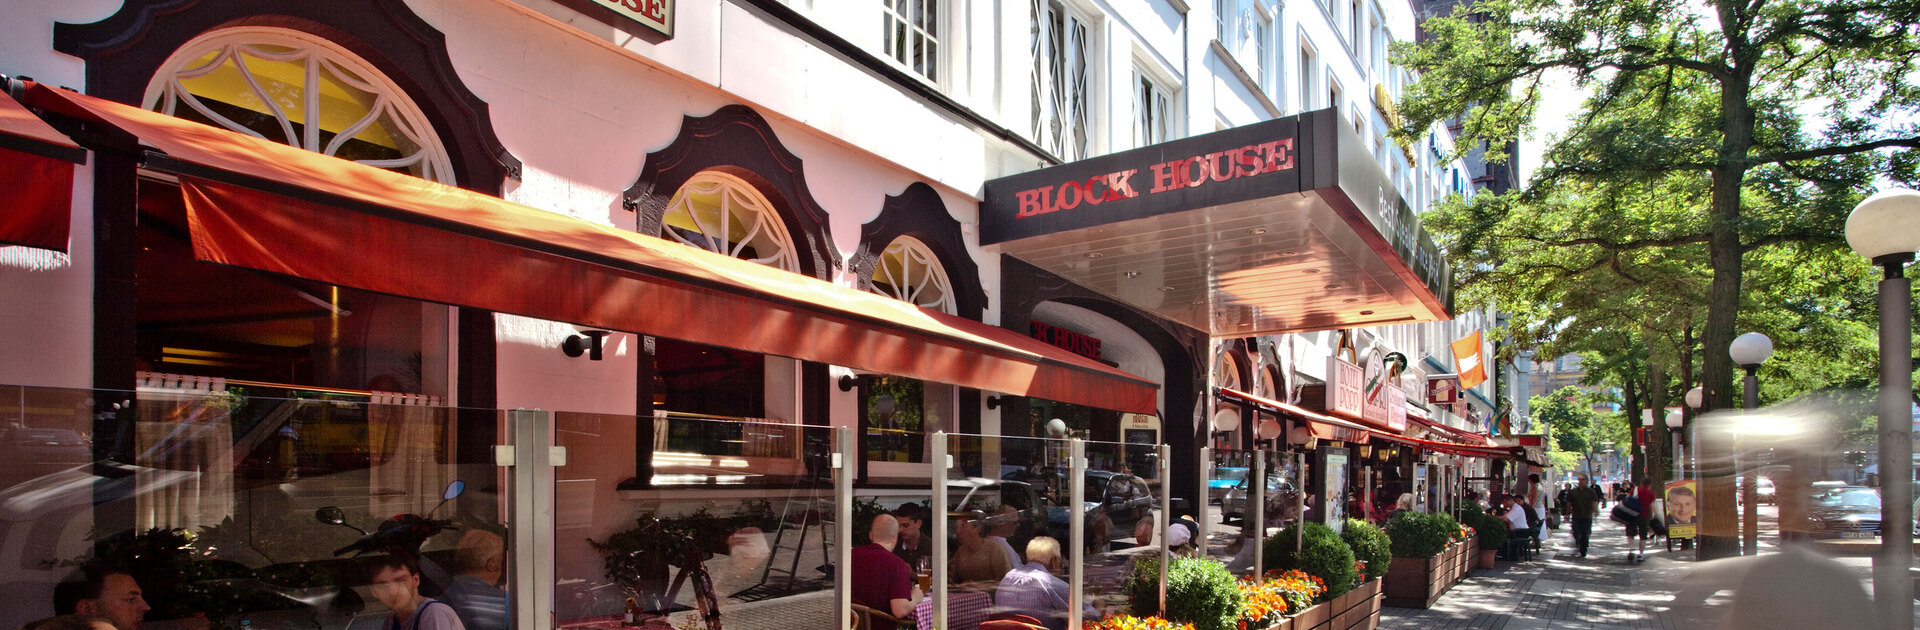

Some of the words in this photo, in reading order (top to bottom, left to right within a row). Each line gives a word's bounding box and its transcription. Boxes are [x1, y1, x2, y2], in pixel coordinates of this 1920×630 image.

[1016, 169, 1139, 218] BLOCK
[1150, 138, 1294, 194] HOUSE
[1378, 184, 1395, 233] Best
[1054, 326, 1101, 360] HOUSE
[1340, 387, 1359, 411] POPP
